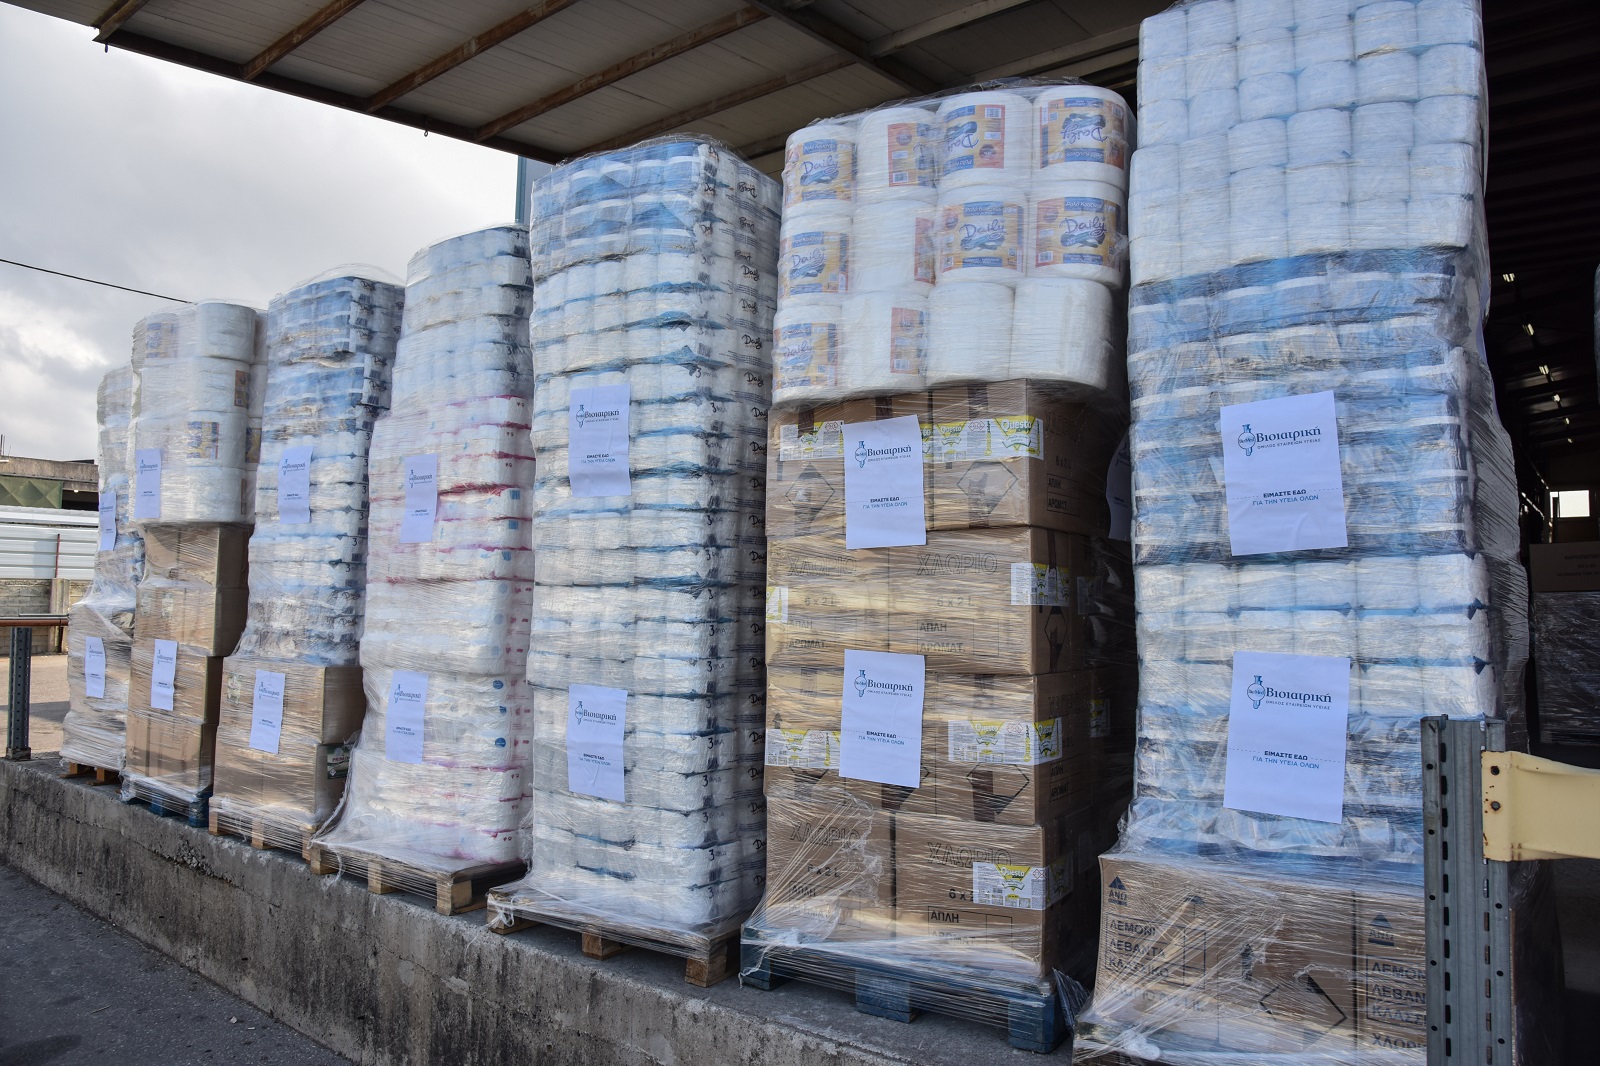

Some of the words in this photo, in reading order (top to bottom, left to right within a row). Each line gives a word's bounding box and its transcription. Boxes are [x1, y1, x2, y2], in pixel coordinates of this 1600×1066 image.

[799, 155, 840, 174] Daily
[959, 218, 1007, 240] Daily
[1059, 216, 1107, 237] Daily
[942, 425, 962, 434] Questo
[1001, 420, 1032, 432] Questo
[1256, 426, 1321, 443] Βιοιατρική
[868, 445, 912, 457] Βιοιατρική
[1263, 490, 1291, 498] ΕΙΜΑΣΤΕ
[917, 552, 998, 576] ΧΛΩΡΙΟ
[920, 622, 947, 632] ΑΠΛΗ
[867, 679, 913, 692] Βιοιατρική
[1266, 687, 1332, 703] Βιοιατρική
[975, 724, 1000, 732] Questo
[708, 737, 714, 750] 3
[1264, 750, 1292, 758] ΕΙΜΑΣΤΕ
[1280, 759, 1298, 767] ΥΓΕΙΑ
[1300, 761, 1320, 769] ΟΛΩΝ
[928, 842, 1012, 868] ΧΛΩΡΙΟ
[1000, 866, 1024, 877] Questo
[948, 888, 956, 899] 6
[1108, 890, 1128, 900] ΑΝΩ
[930, 911, 960, 924] ΑΠΛΗ
[1110, 920, 1156, 936] ΛΕΜΟΝΙ
[1110, 939, 1165, 958] ΛΕΒΑΝΤΑ
